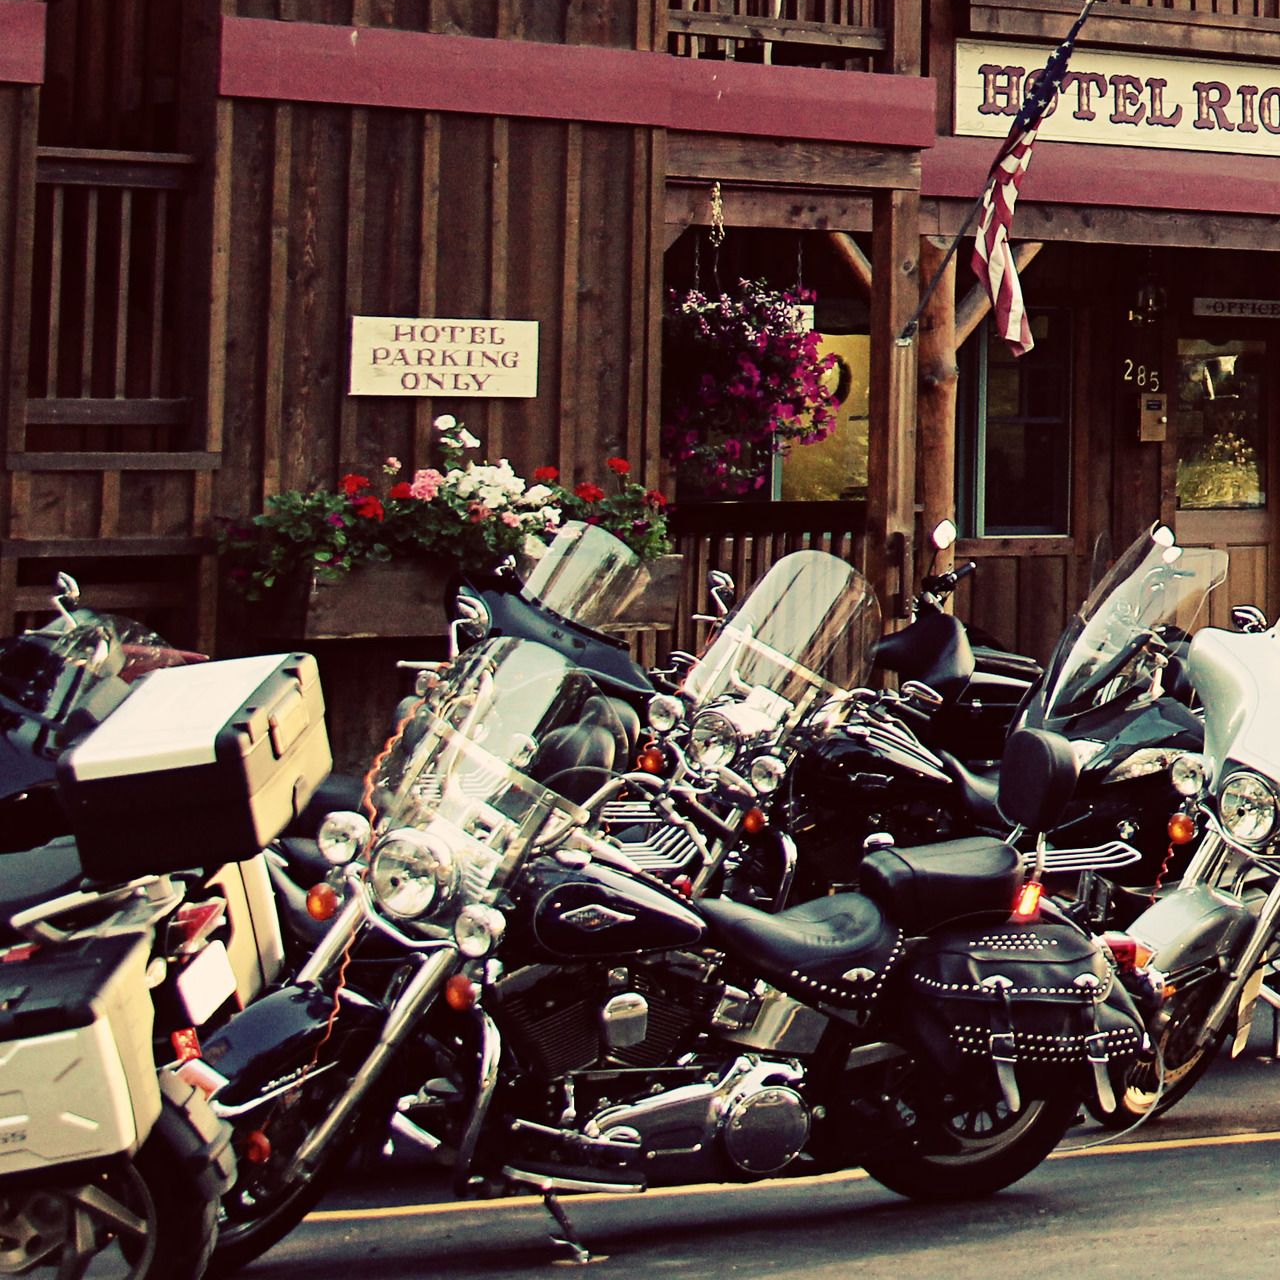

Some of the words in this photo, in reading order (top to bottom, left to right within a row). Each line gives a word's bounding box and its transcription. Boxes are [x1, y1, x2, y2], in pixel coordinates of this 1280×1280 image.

[978, 63, 1183, 127] HOTEL
[1212, 301, 1280, 316] OFFICE
[392, 324, 505, 345] HOTEL
[371, 347, 520, 369] PARKING
[400, 372, 492, 391] ONLY
[1124, 358, 1160, 392] 285
